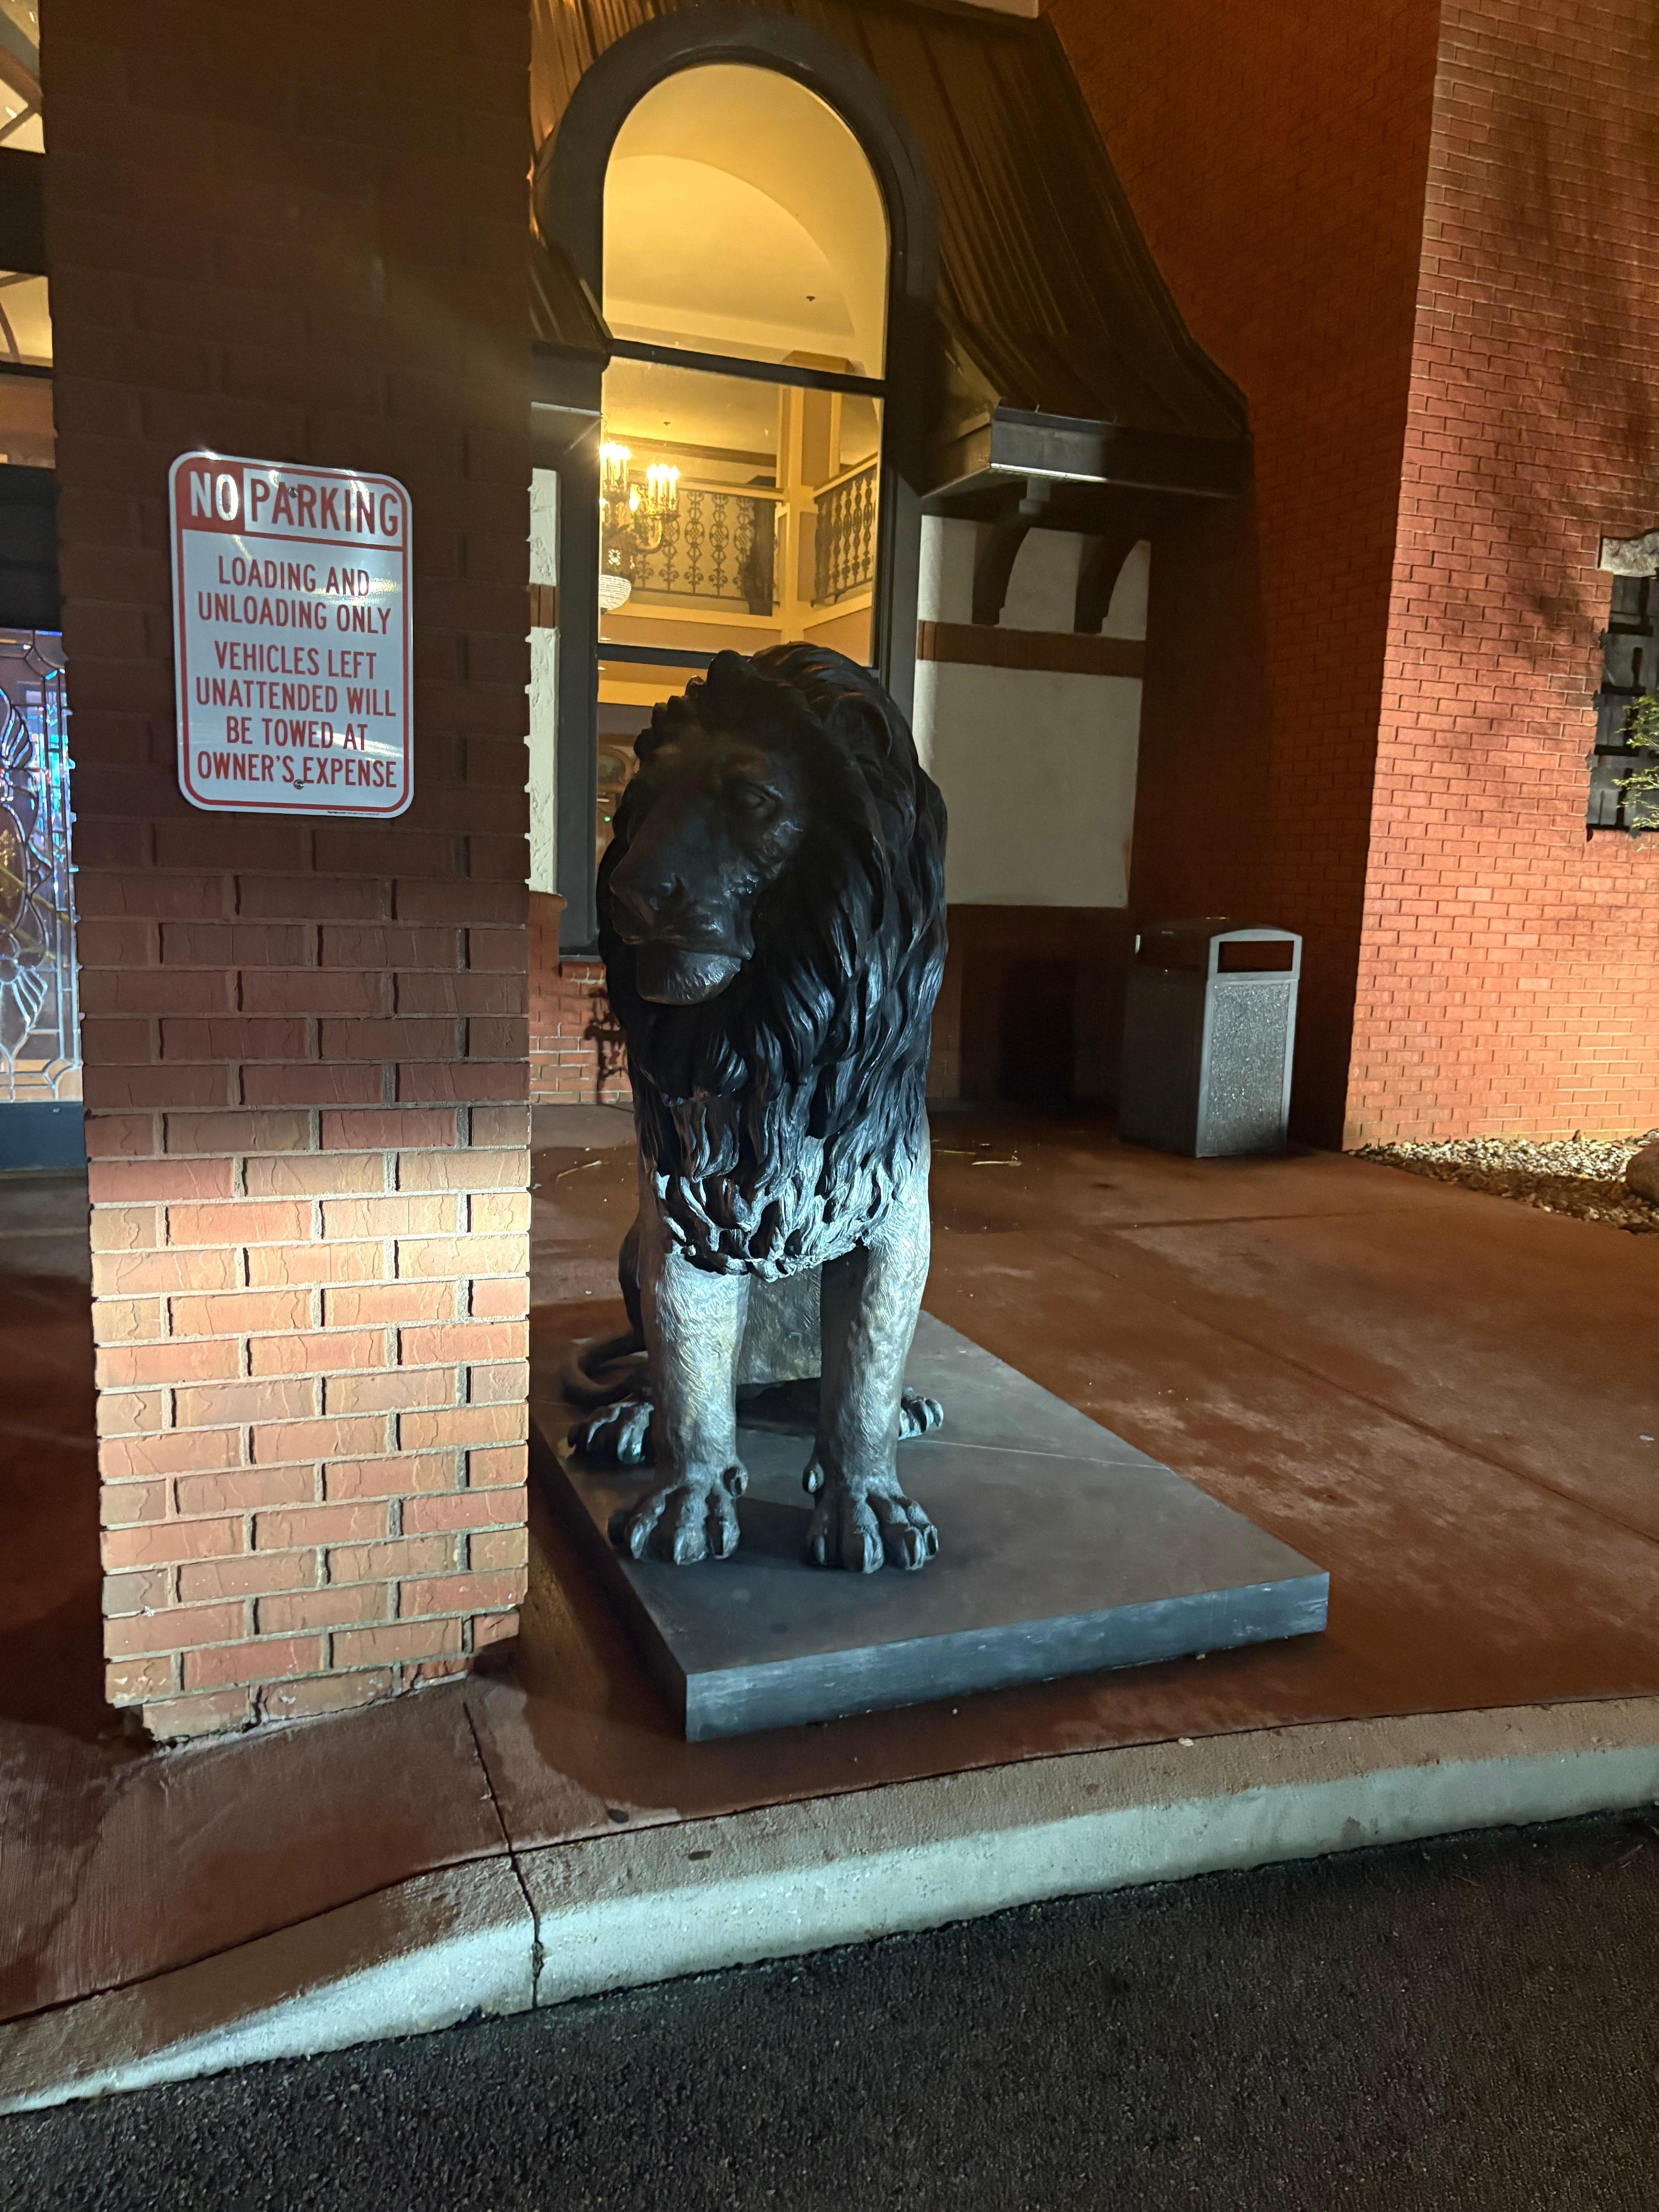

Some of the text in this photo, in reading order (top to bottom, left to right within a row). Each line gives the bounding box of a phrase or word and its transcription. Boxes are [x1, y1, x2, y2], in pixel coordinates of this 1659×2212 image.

[190, 471, 398, 537] NO PARKING
[218, 556, 369, 596] LOADING AND
[198, 591, 391, 635] UNLOADING ONLY
[214, 640, 377, 679] VEHICLES LEFT
[196, 677, 397, 717] UNATTENDED WILL
[226, 716, 368, 750] BE TOWED AT
[198, 750, 397, 788] OWNER'S EXPENSE
